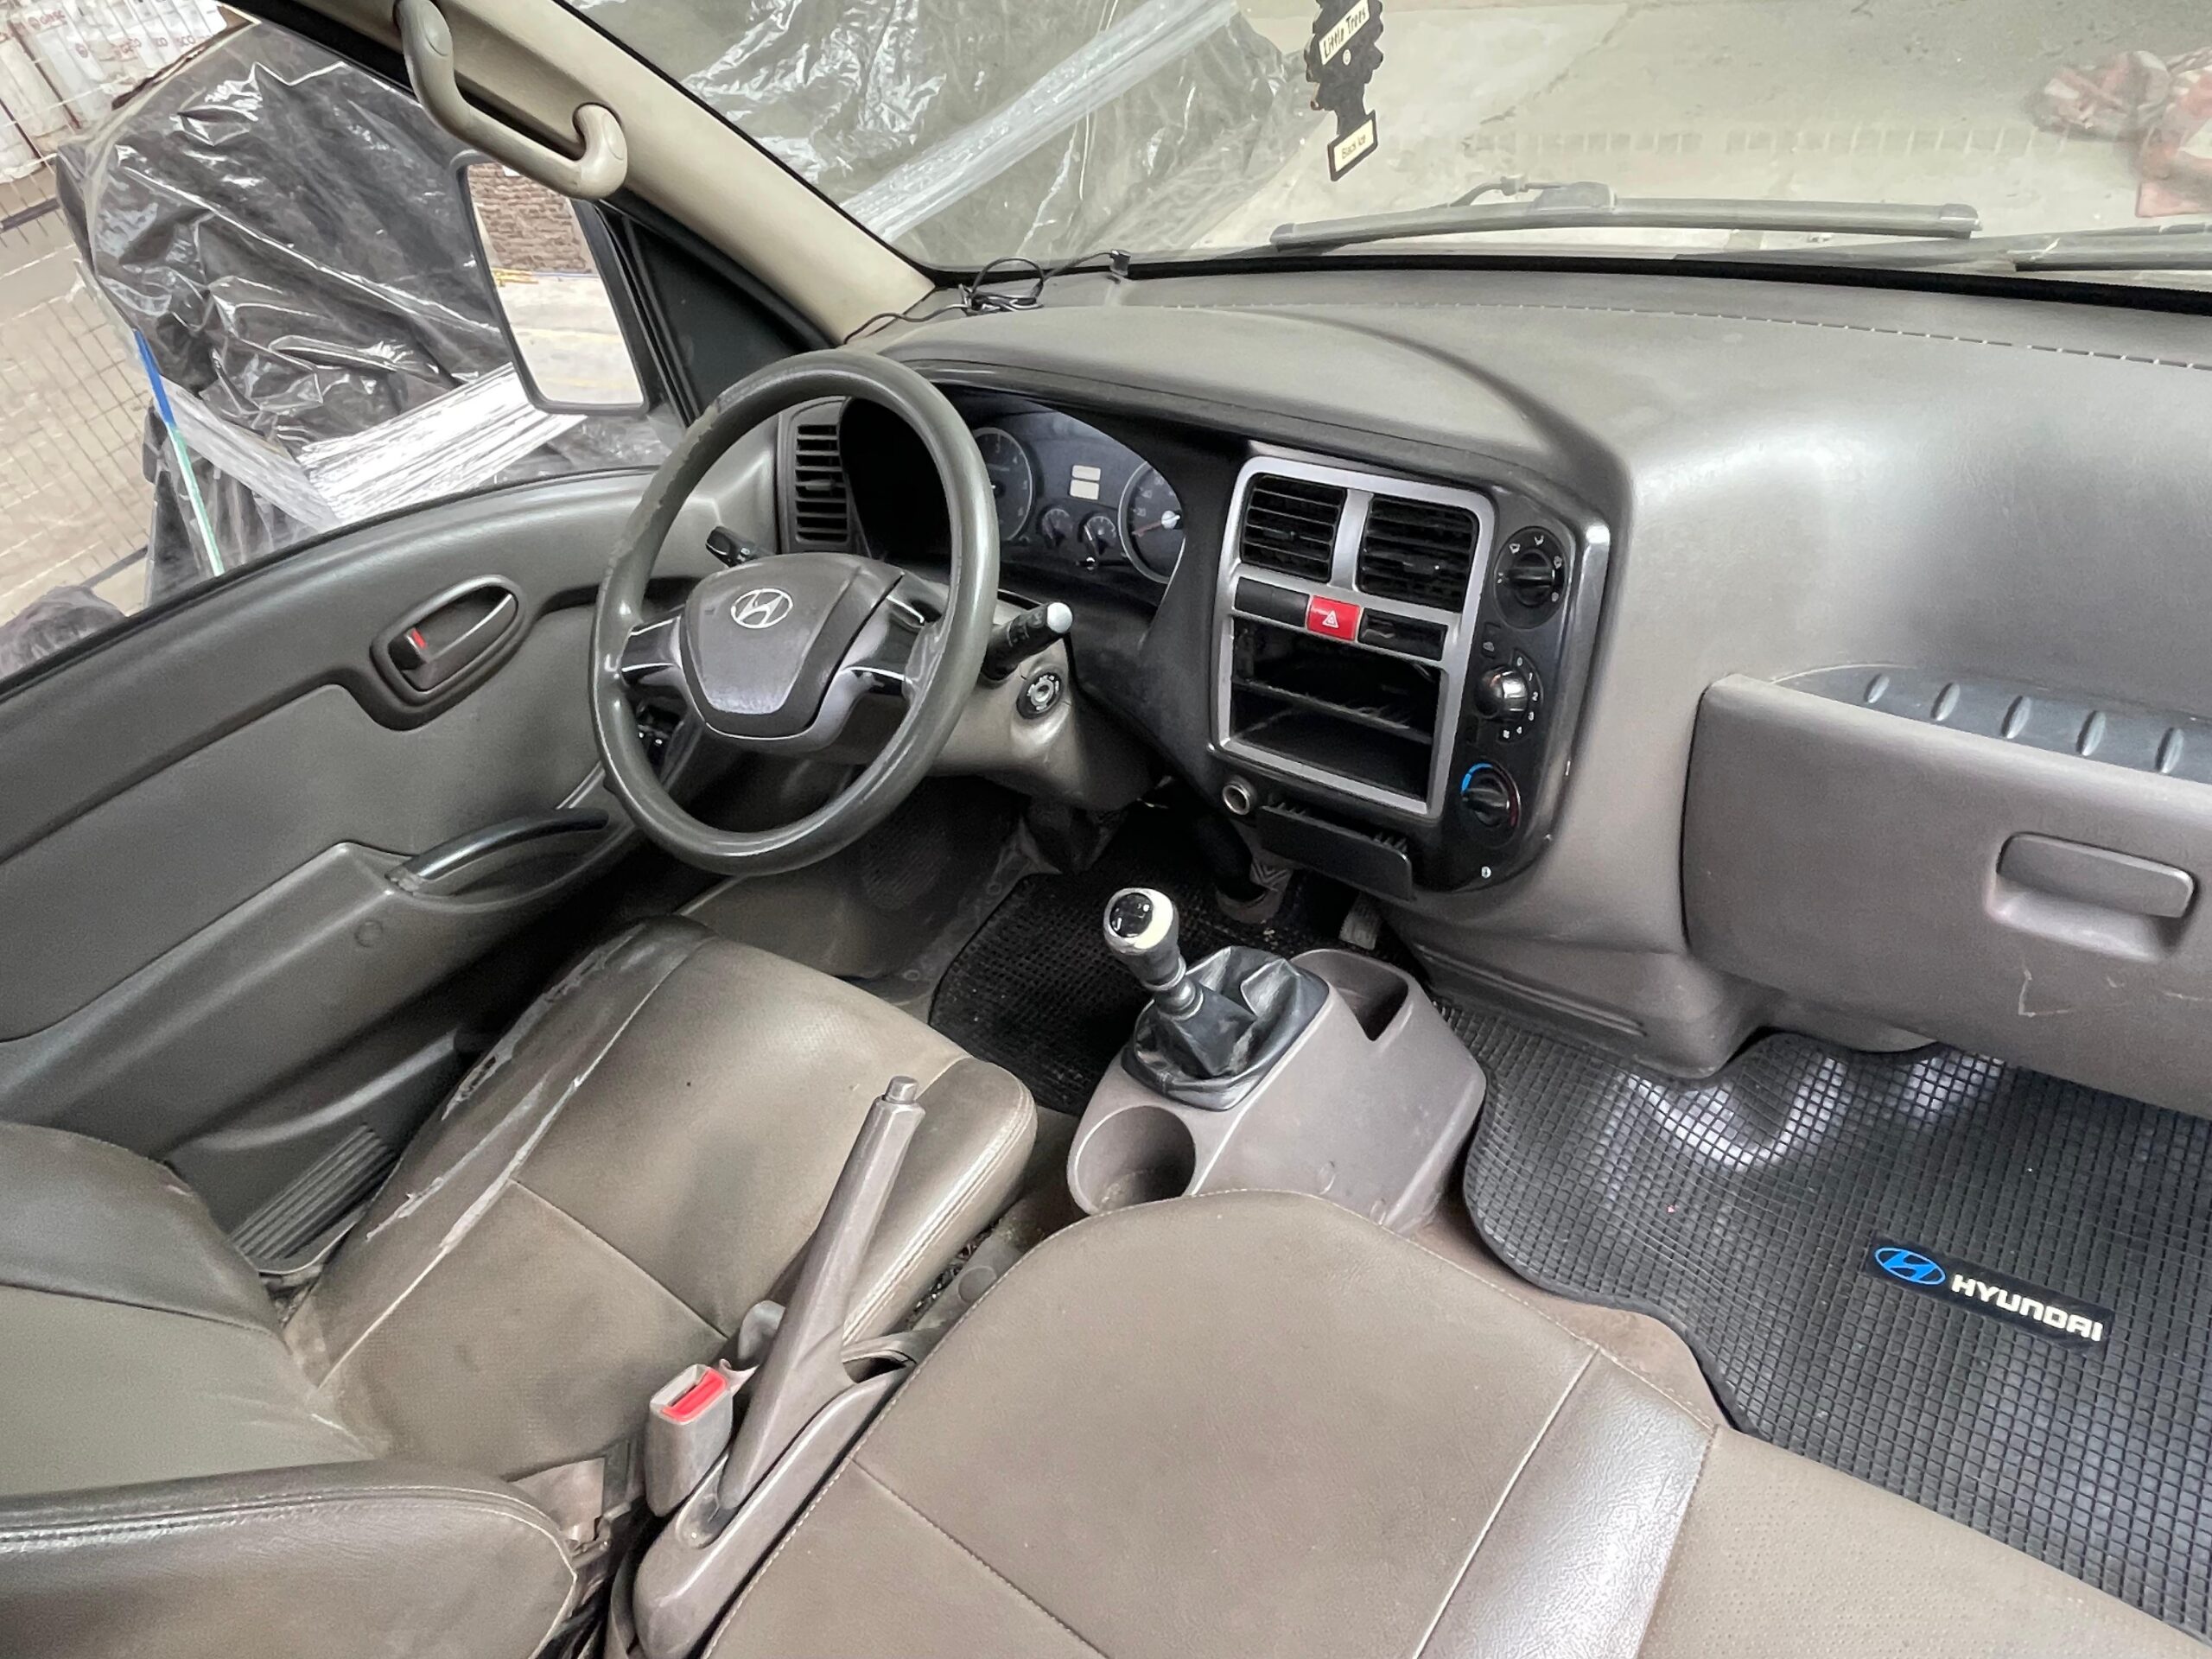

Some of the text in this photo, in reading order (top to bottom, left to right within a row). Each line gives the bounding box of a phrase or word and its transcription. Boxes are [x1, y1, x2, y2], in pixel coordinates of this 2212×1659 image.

[1323, 7, 1366, 59] Little Trees
[1532, 691, 1538, 701] 2
[1951, 1274, 2103, 1342] HYUNDAI
